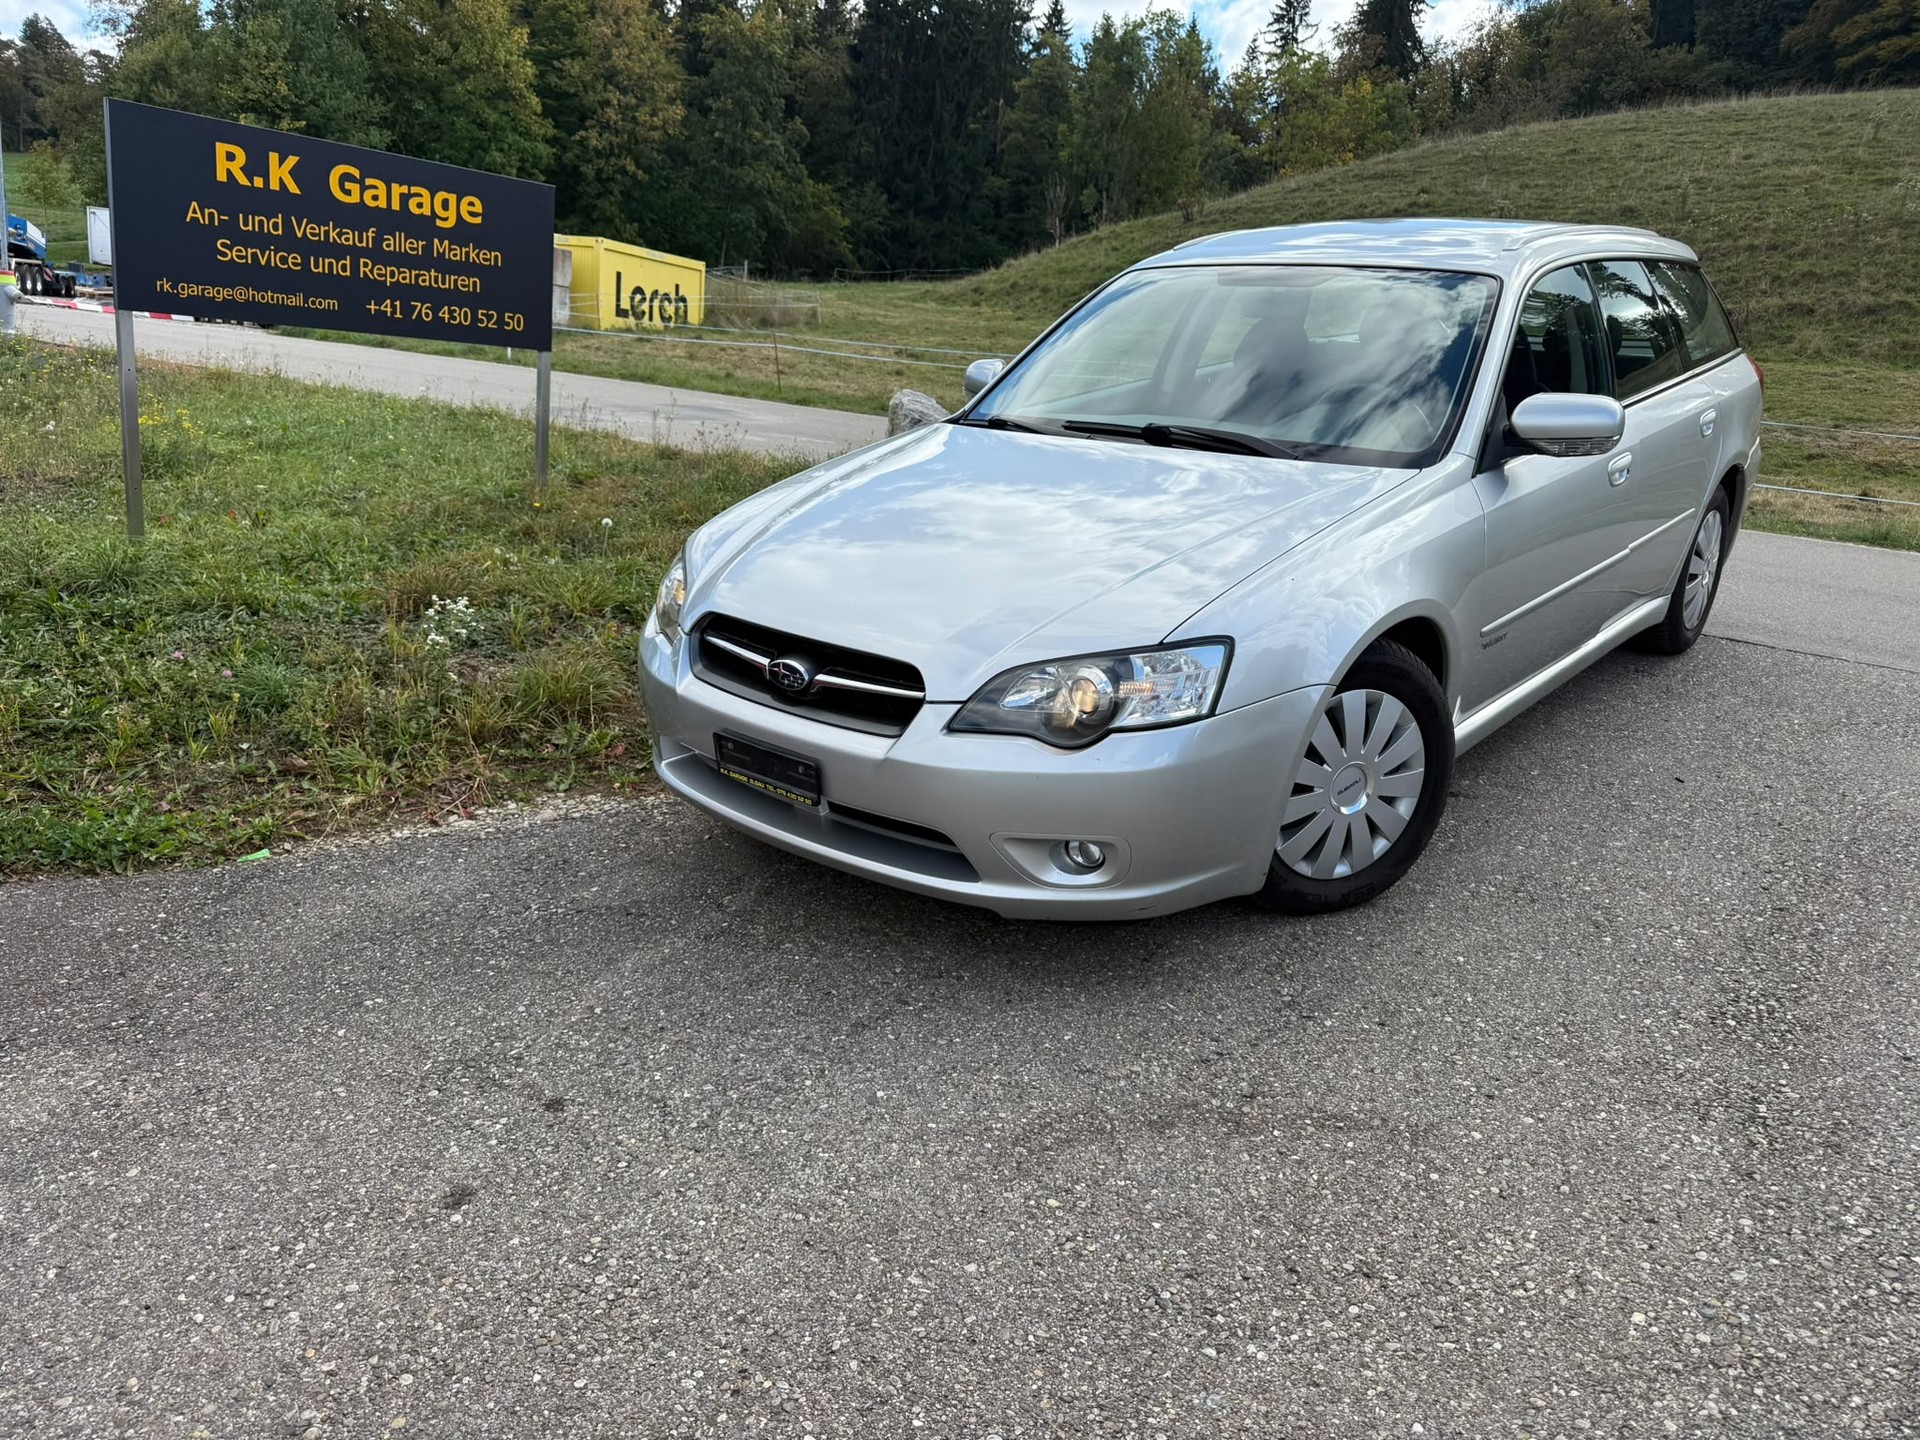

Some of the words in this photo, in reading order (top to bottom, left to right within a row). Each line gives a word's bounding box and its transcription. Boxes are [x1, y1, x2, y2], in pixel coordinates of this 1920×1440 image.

[215, 141, 302, 195] R.K
[328, 163, 485, 230] Garage
[186, 201, 229, 226] An-
[239, 213, 284, 237] und
[291, 217, 377, 249] Verkauf
[382, 232, 426, 256] aller
[433, 239, 503, 267] Marken
[216, 239, 302, 272] Service
[309, 255, 352, 278] und
[359, 257, 481, 293] Reparaturen
[156, 279, 339, 311] rk.garage@hotmail.com
[366, 299, 403, 320] +41
[412, 302, 434, 322] 76
[438, 306, 473, 327] 430
[477, 309, 498, 329] 52
[504, 312, 526, 332] 50
[615, 271, 689, 324] Lerch
